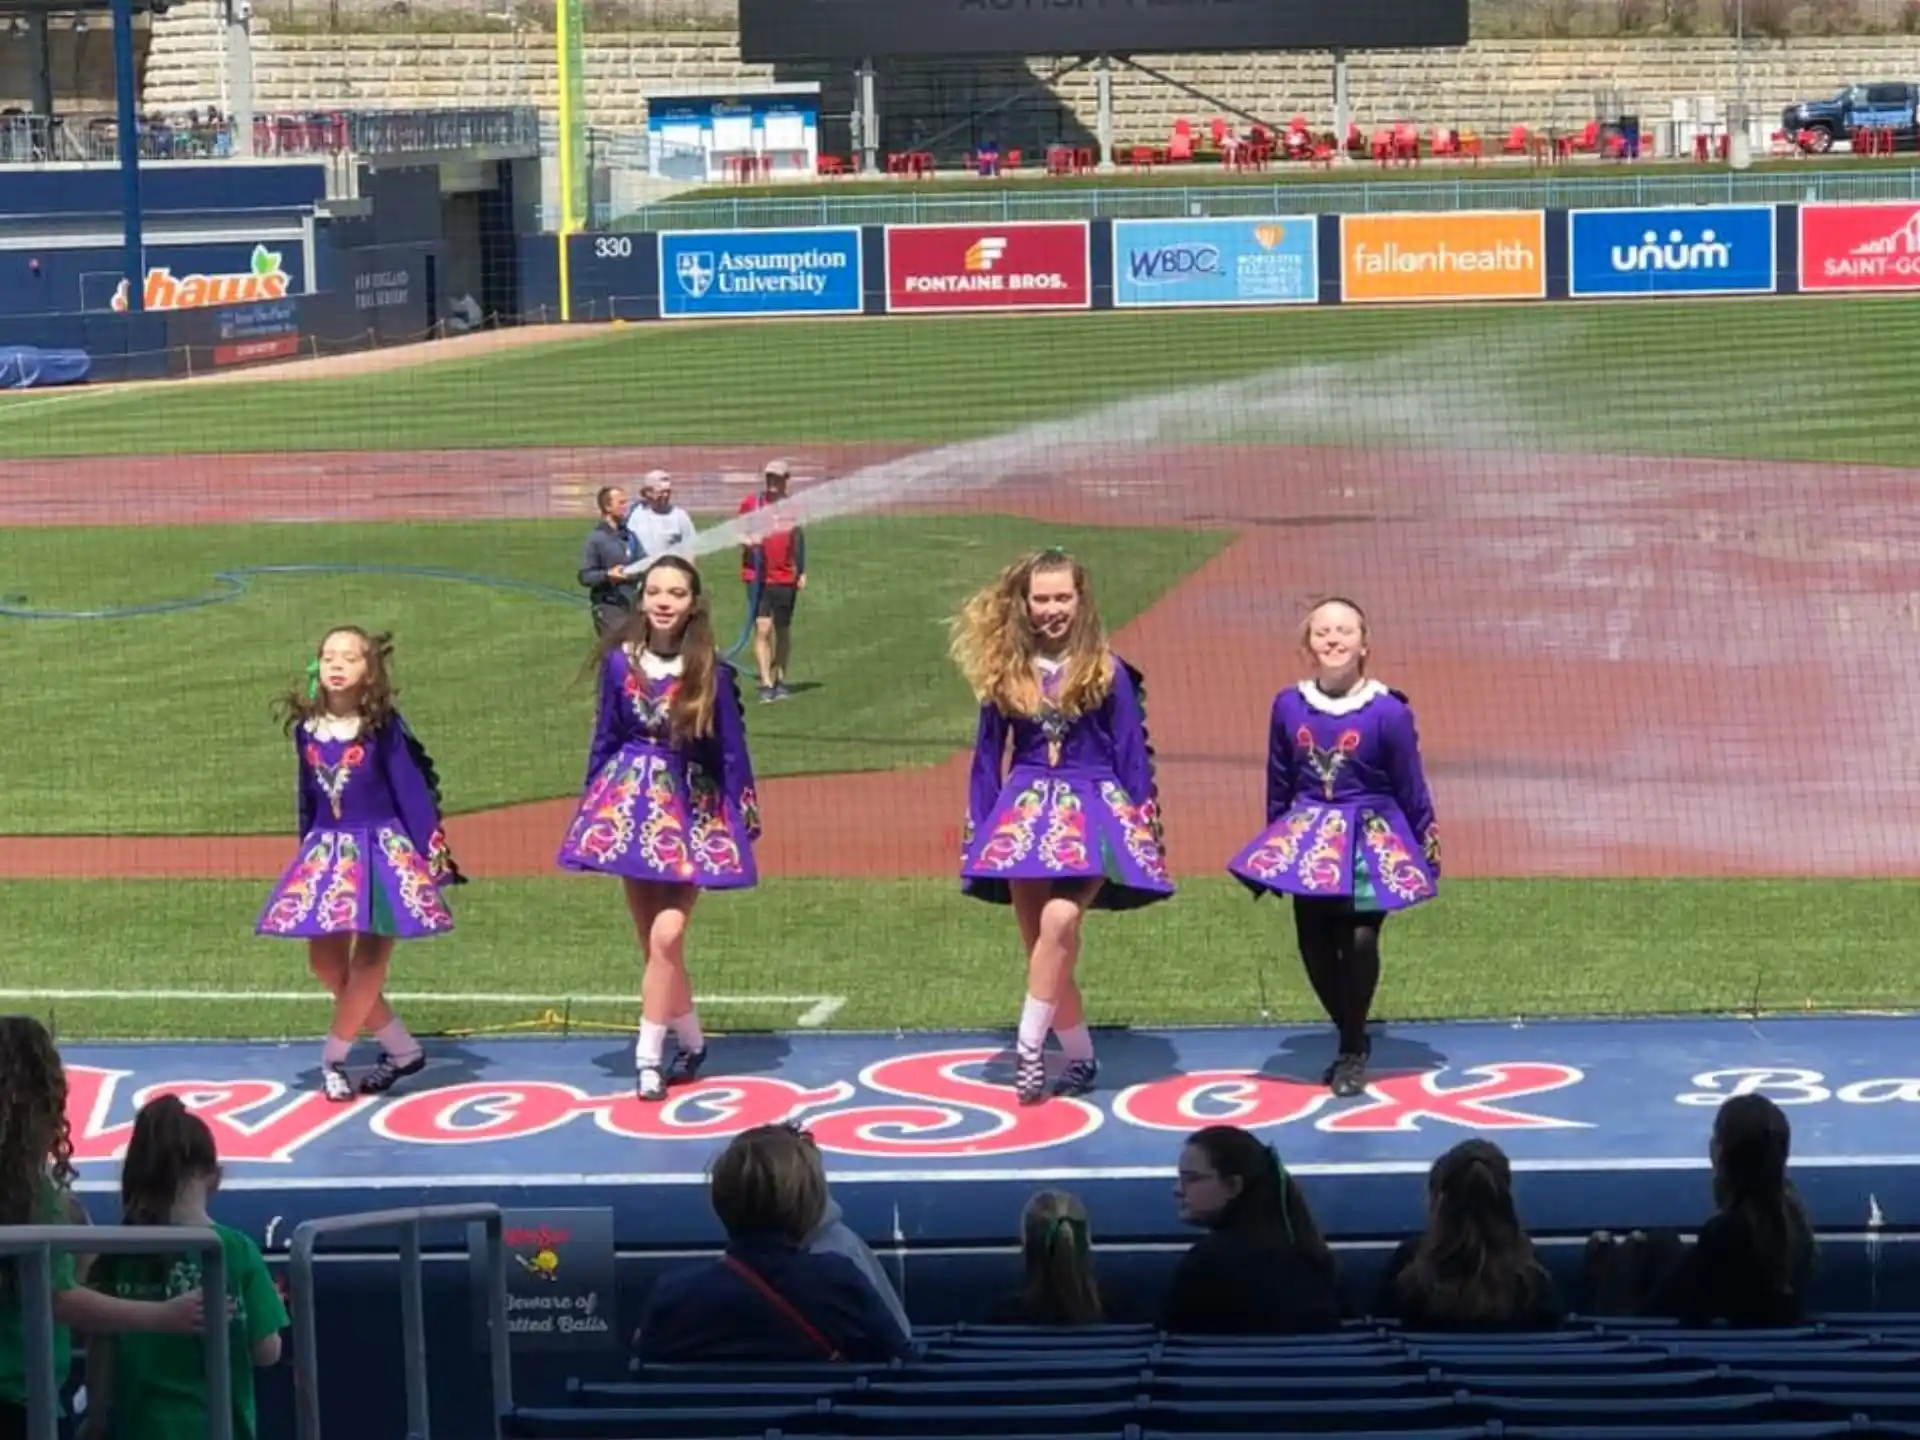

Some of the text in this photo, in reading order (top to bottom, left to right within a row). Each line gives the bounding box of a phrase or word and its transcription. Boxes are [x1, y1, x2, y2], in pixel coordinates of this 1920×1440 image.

[595, 236, 632, 258] 330
[1354, 239, 1535, 275] fallonhealth
[1611, 230, 1729, 271] unum
[718, 248, 847, 272] Assumption
[1130, 246, 1220, 278] WBDC
[718, 271, 828, 295] University
[905, 273, 1068, 291] FONTAINE BROS.
